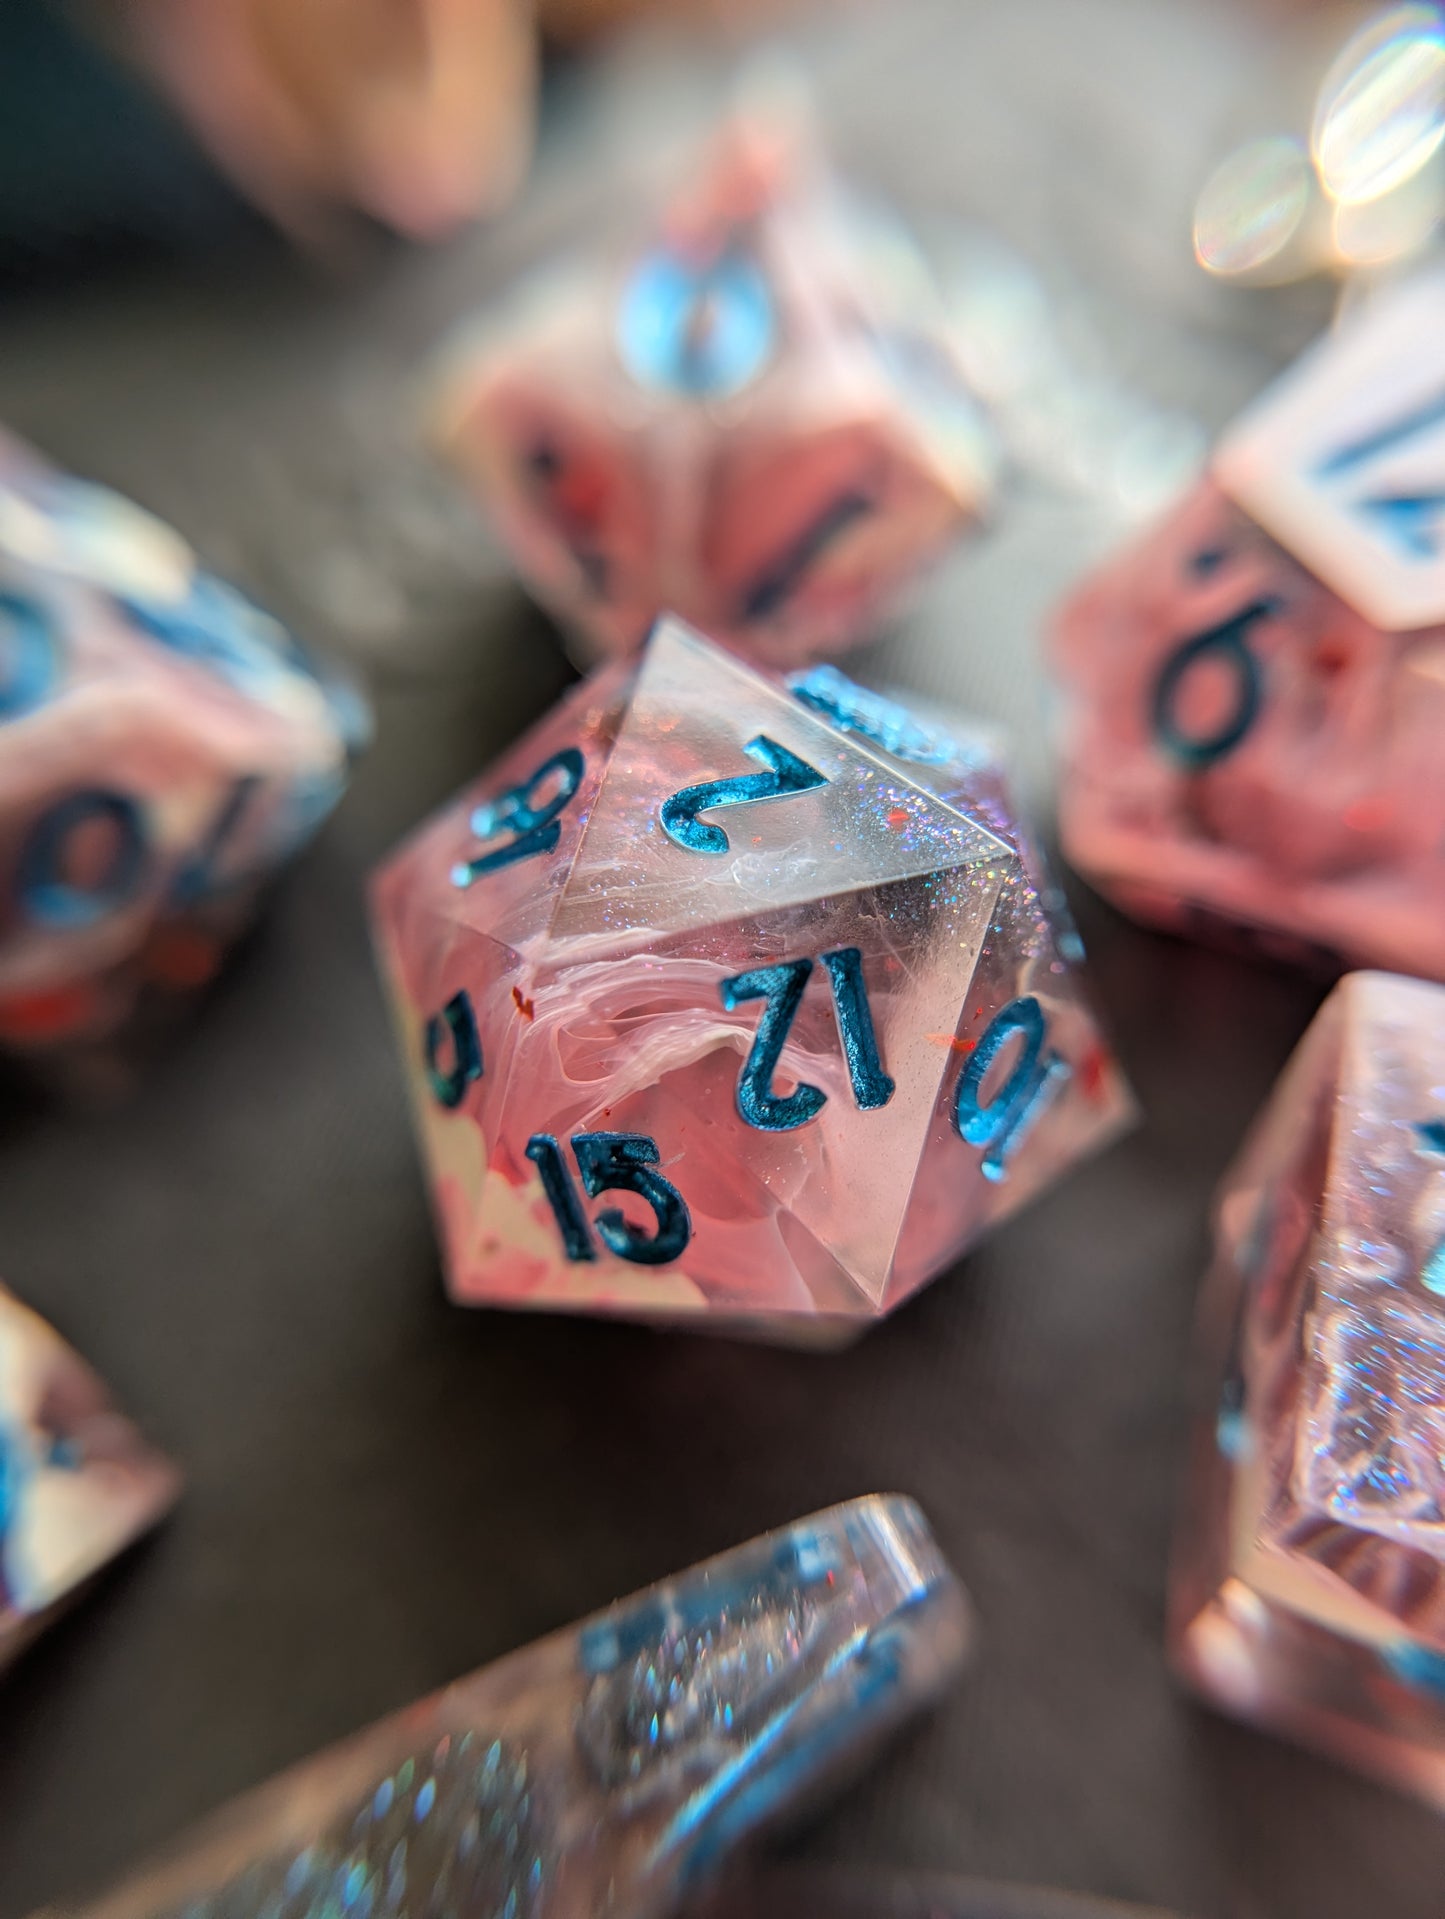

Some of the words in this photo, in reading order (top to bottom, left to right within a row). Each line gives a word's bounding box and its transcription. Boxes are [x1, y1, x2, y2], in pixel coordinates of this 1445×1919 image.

[660, 734, 832, 855] 2
[719, 946, 895, 1132] 12
[525, 1131, 693, 1266] 15
